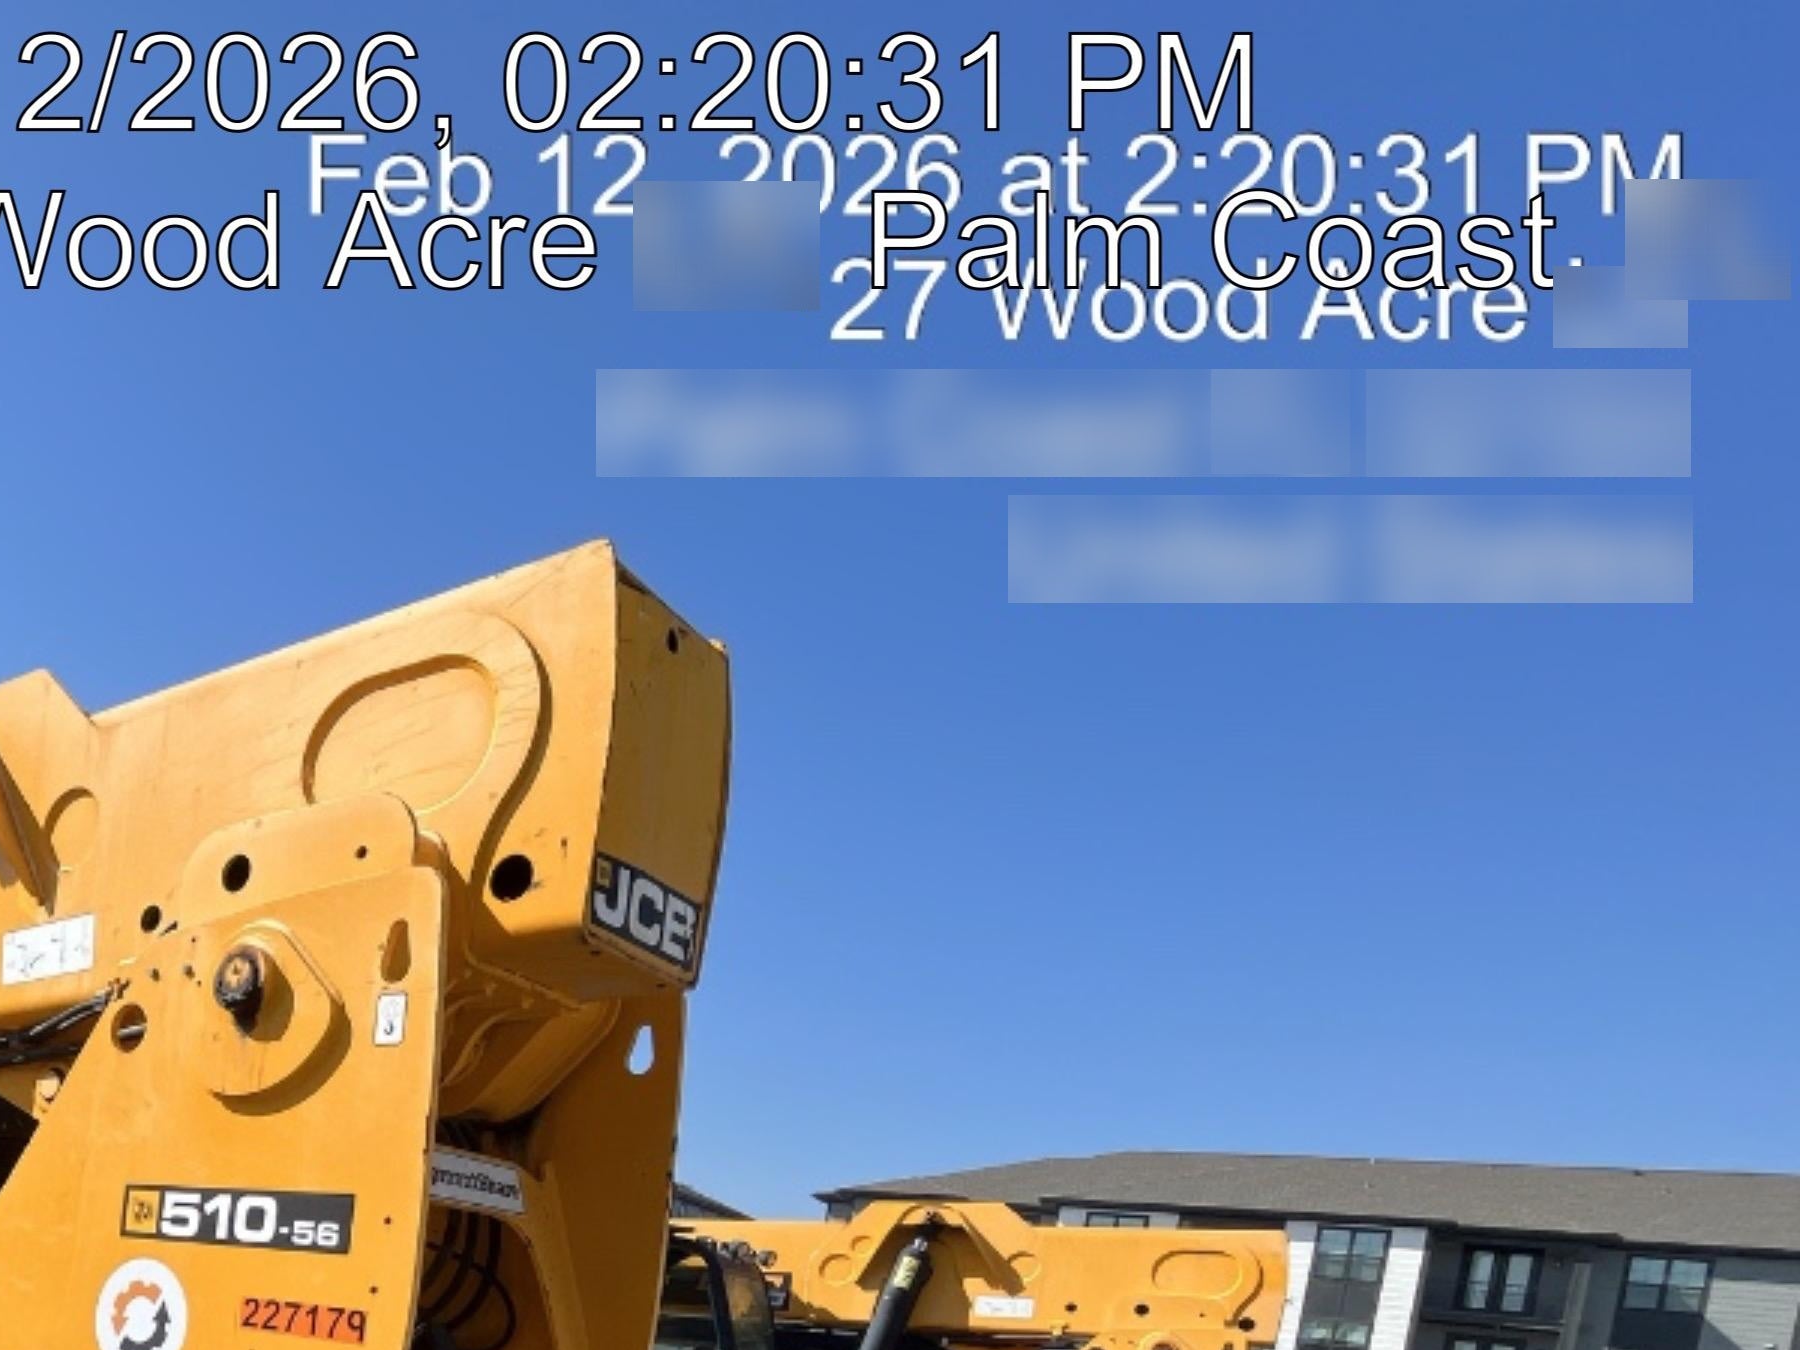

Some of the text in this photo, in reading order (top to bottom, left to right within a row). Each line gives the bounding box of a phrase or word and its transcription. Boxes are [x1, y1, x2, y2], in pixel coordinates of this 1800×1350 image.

[593, 867, 698, 961] JCB
[159, 1191, 341, 1248] 510-56
[241, 1297, 369, 1344] 227179
